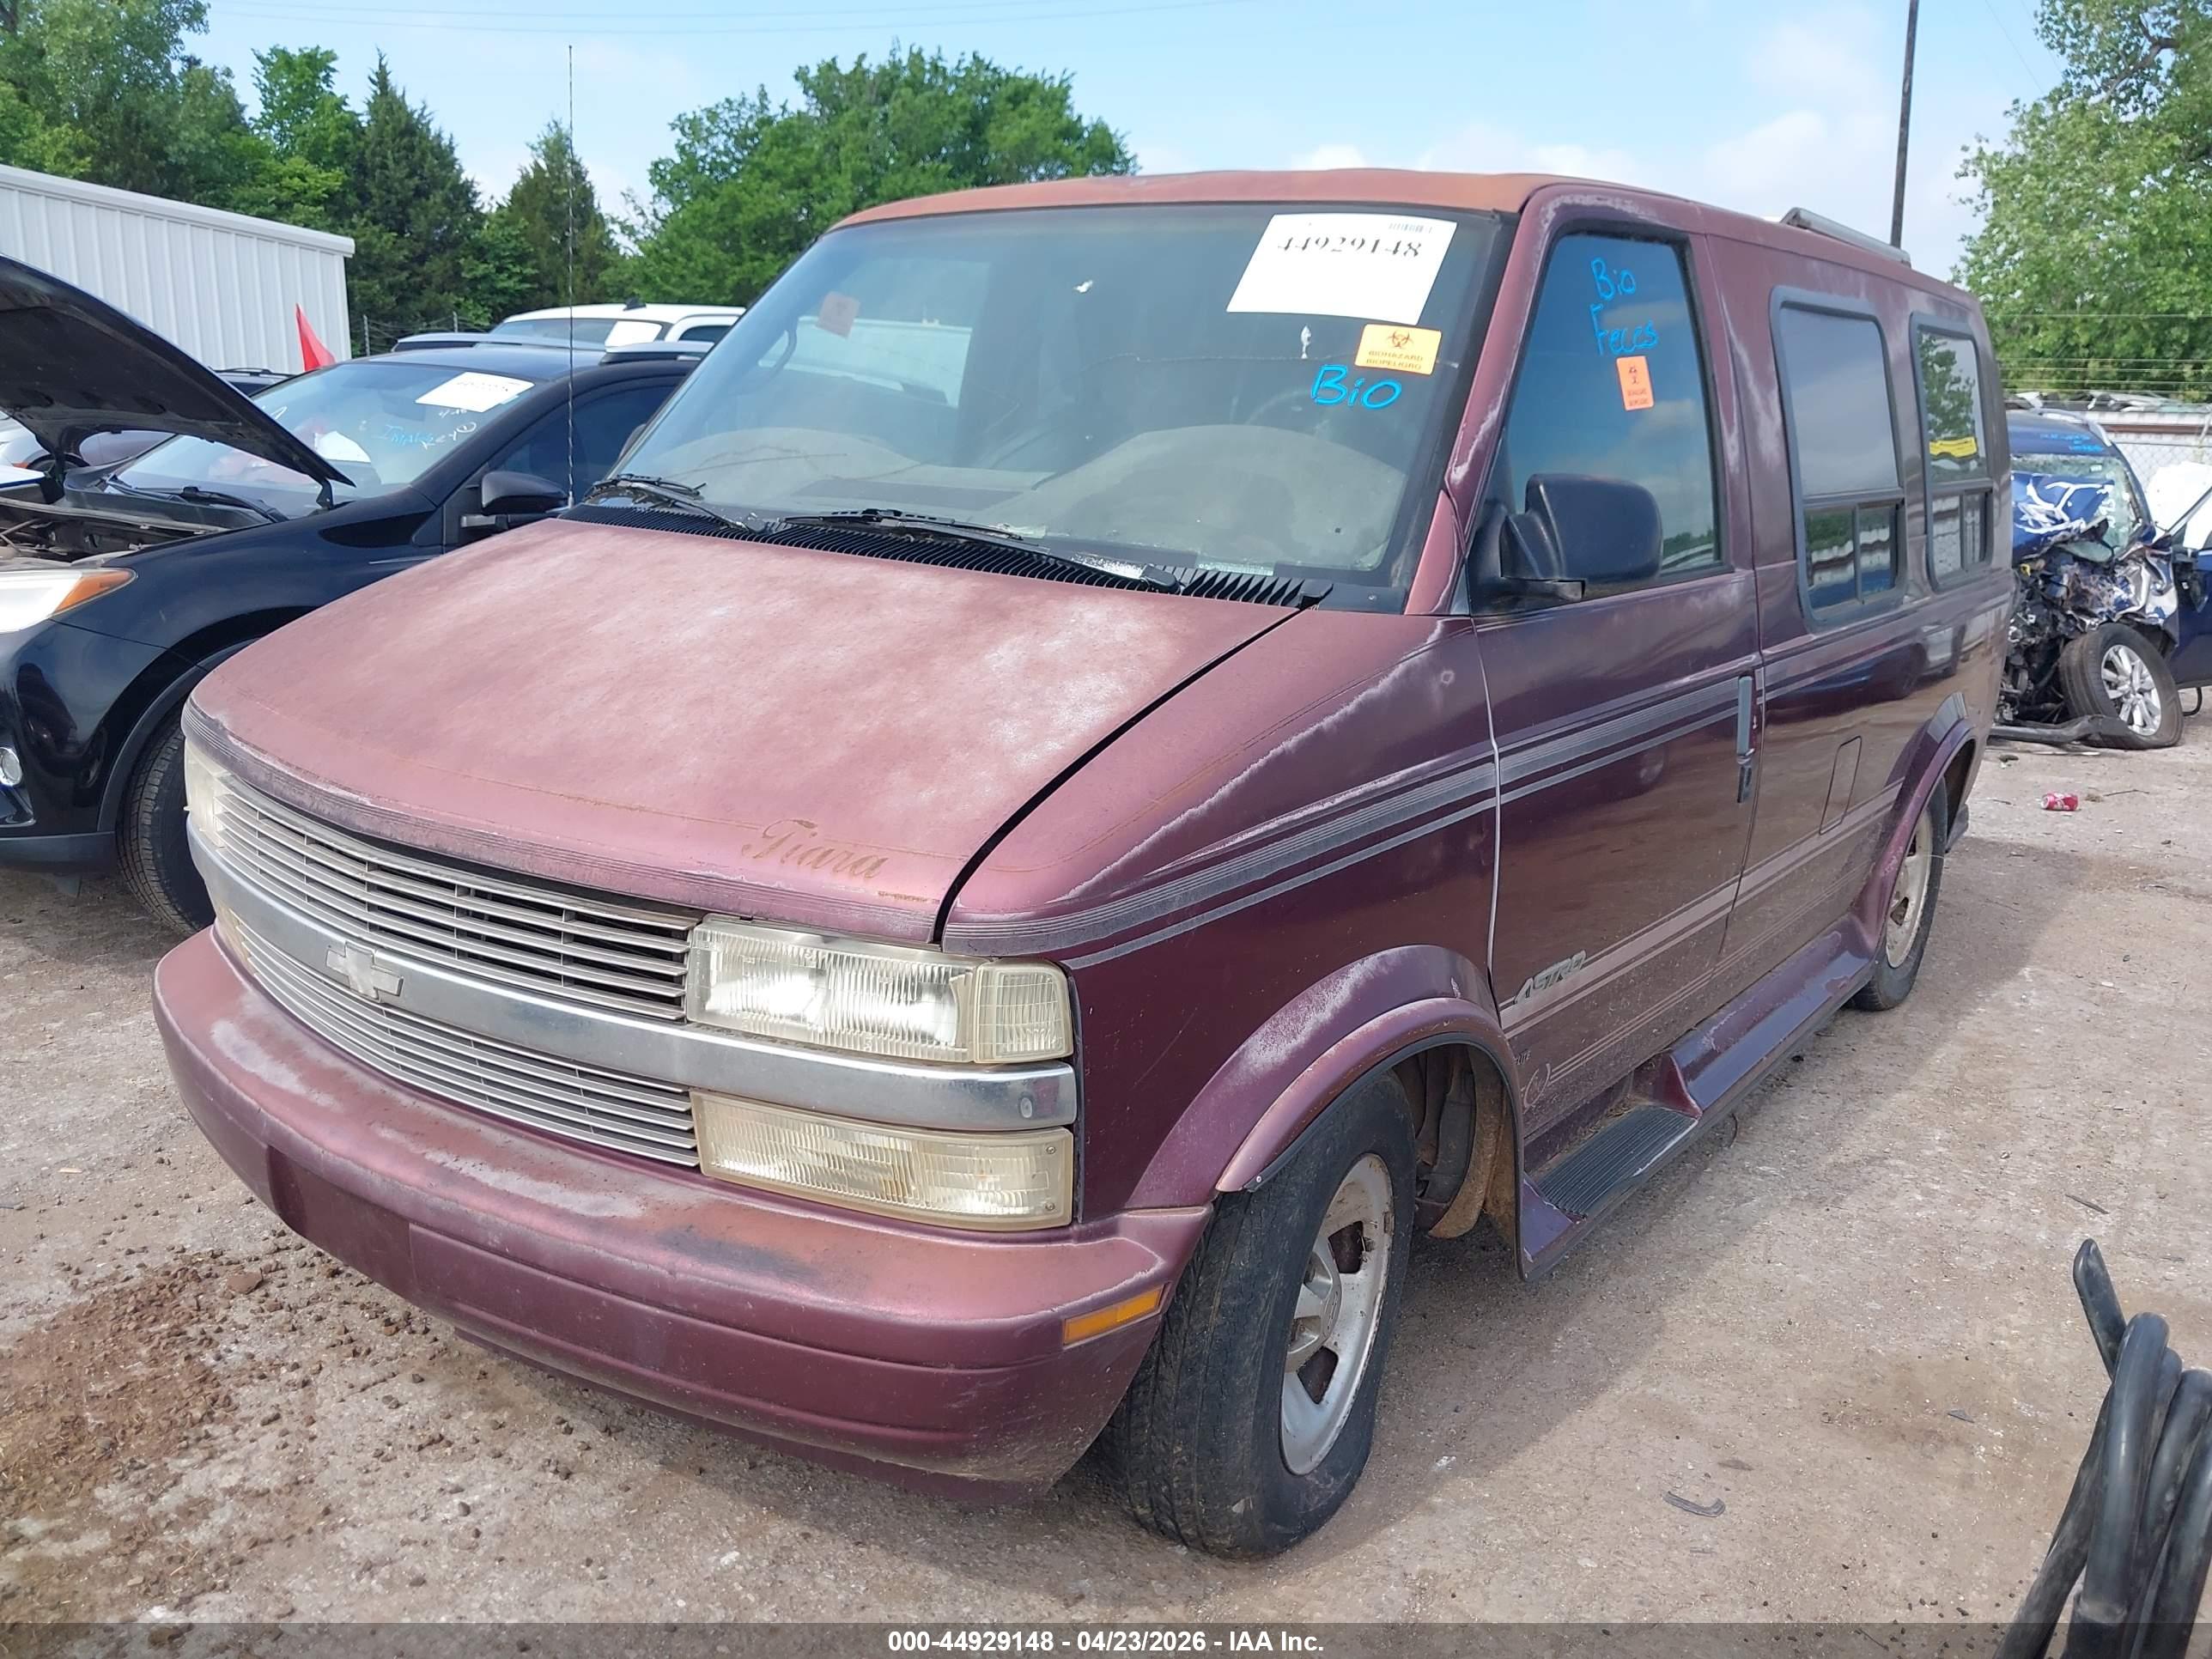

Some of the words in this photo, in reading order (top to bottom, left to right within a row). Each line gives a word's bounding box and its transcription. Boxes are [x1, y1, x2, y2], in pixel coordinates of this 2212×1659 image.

[1277, 235, 1423, 258] 44929148
[741, 819, 889, 879] Tiara
[1513, 949, 1587, 1005] ASTRO
